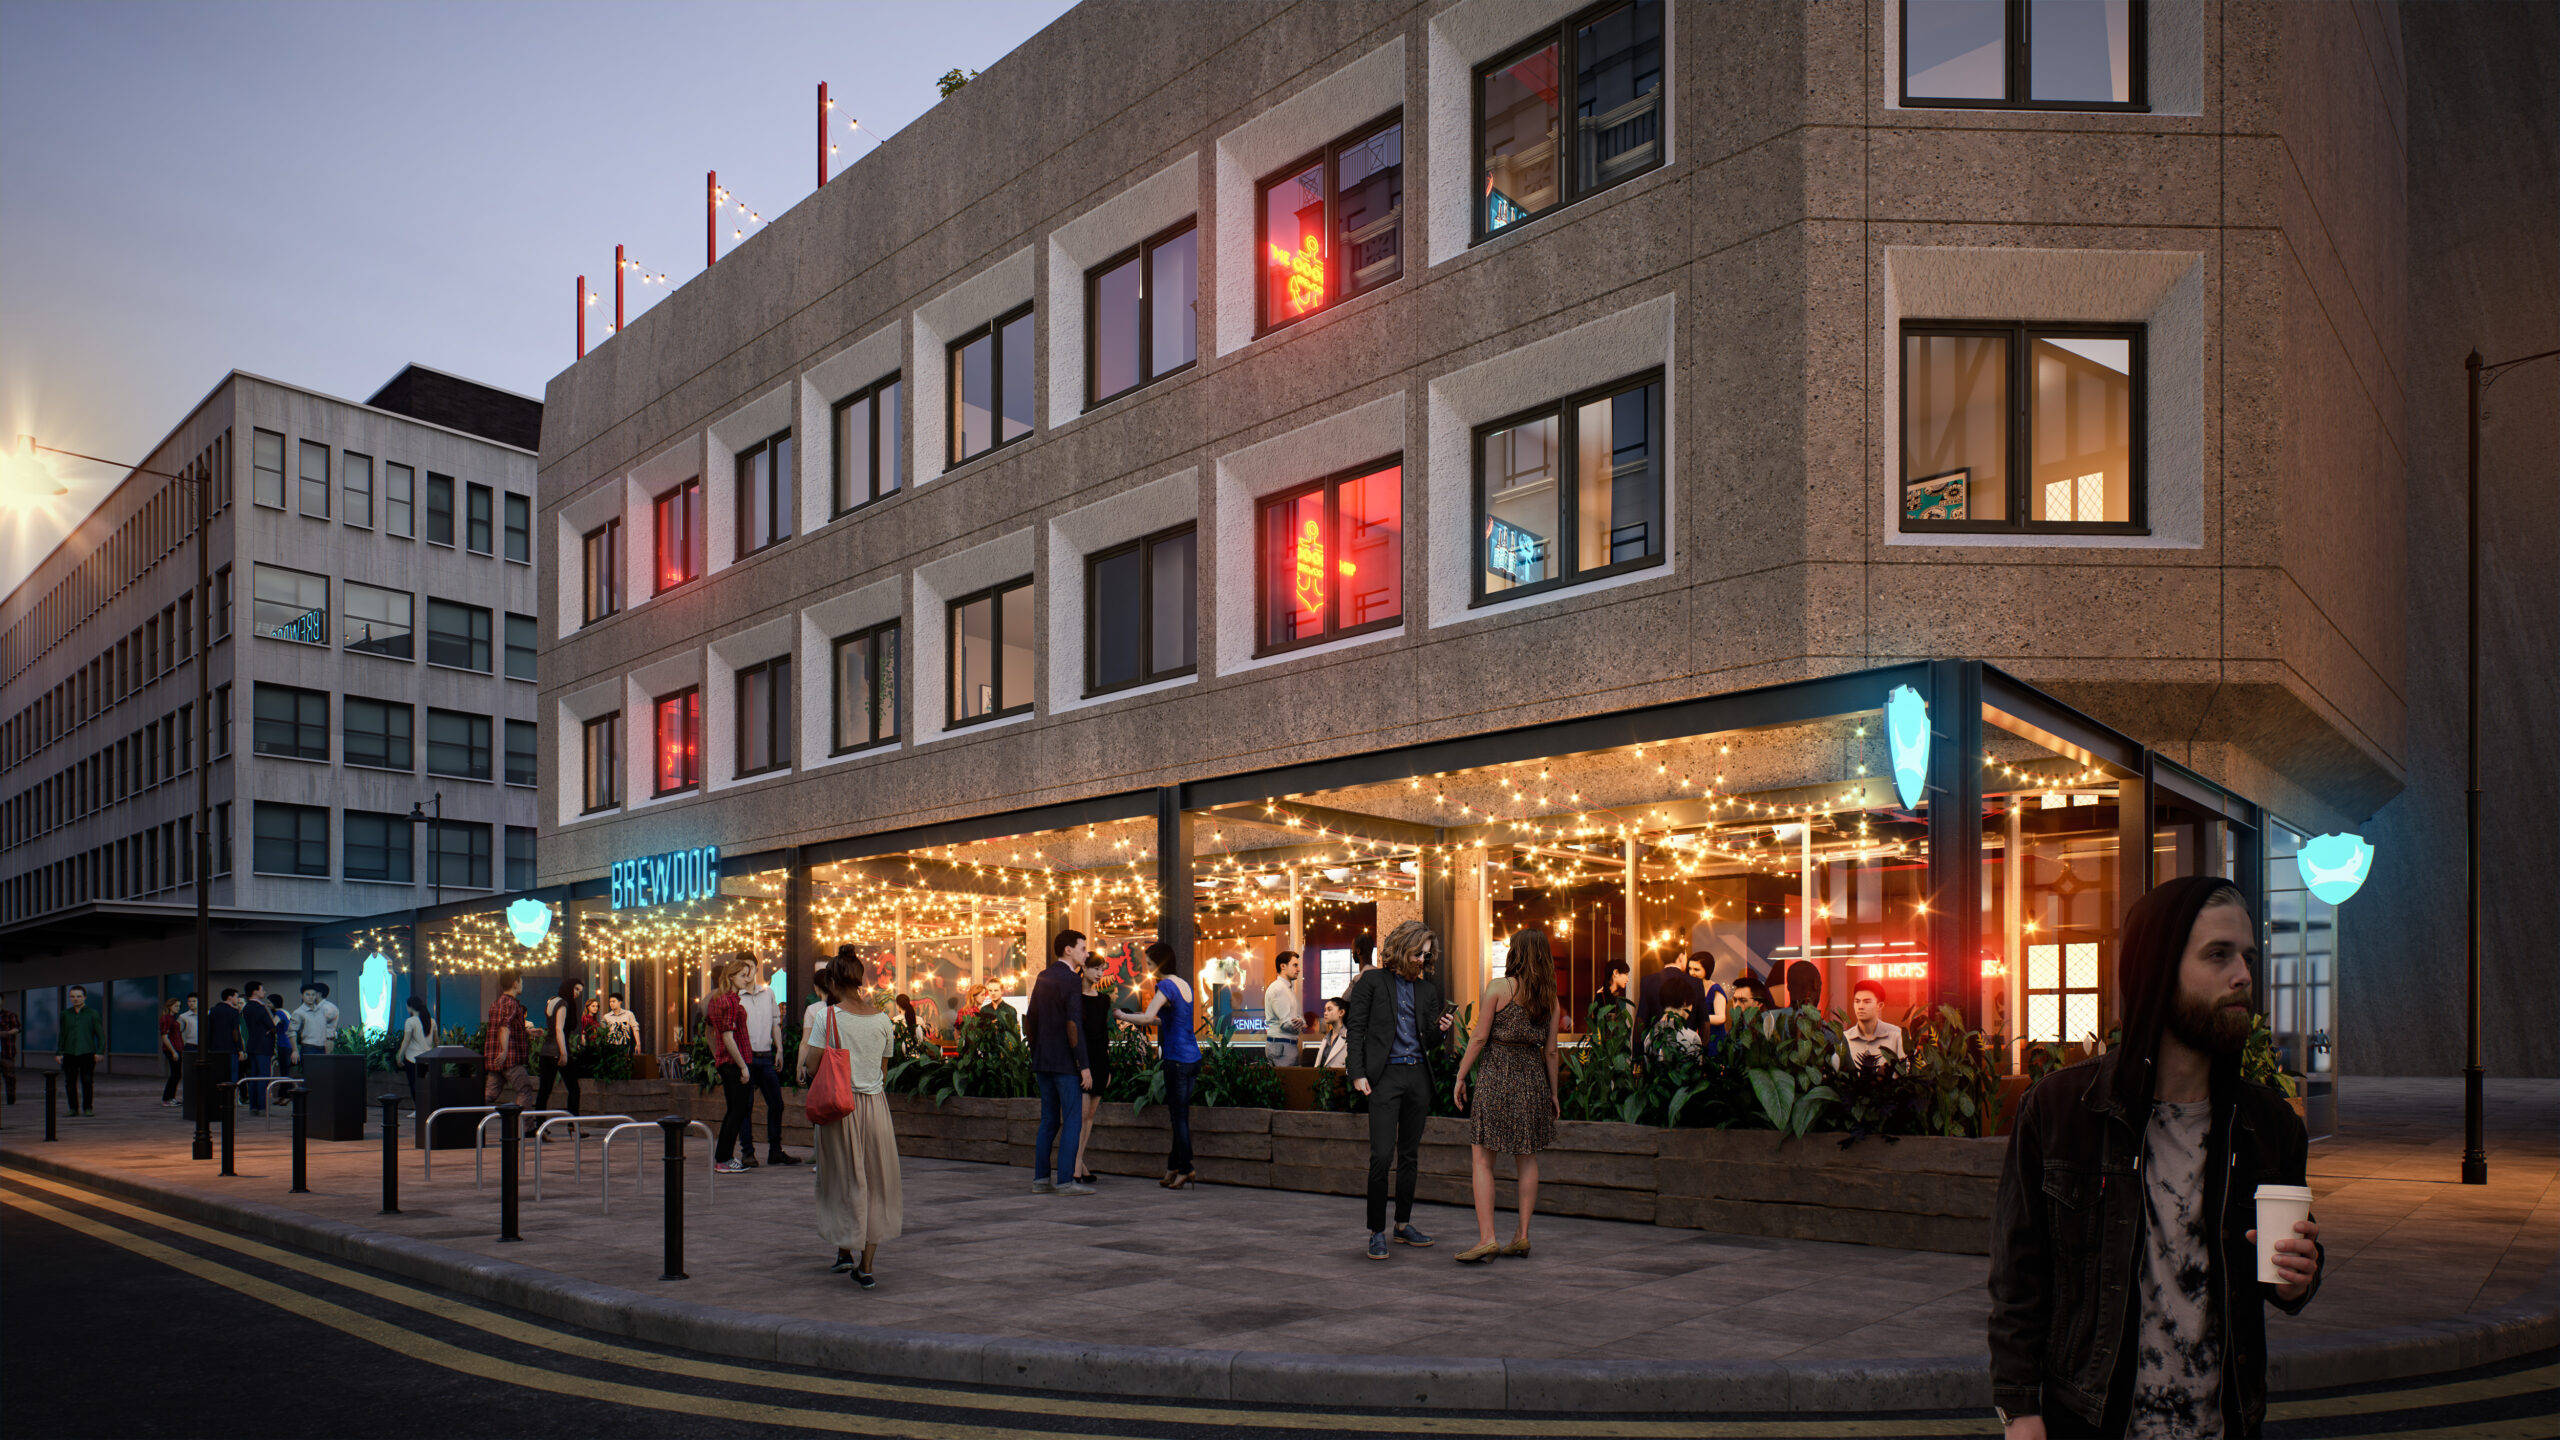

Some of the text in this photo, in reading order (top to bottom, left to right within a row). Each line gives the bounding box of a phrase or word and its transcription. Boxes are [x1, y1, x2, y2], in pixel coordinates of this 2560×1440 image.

[611, 844, 718, 910] BREWDOG
[1868, 962, 1926, 979] IN HOPS
[1233, 1018, 1270, 1030] KENNELS
